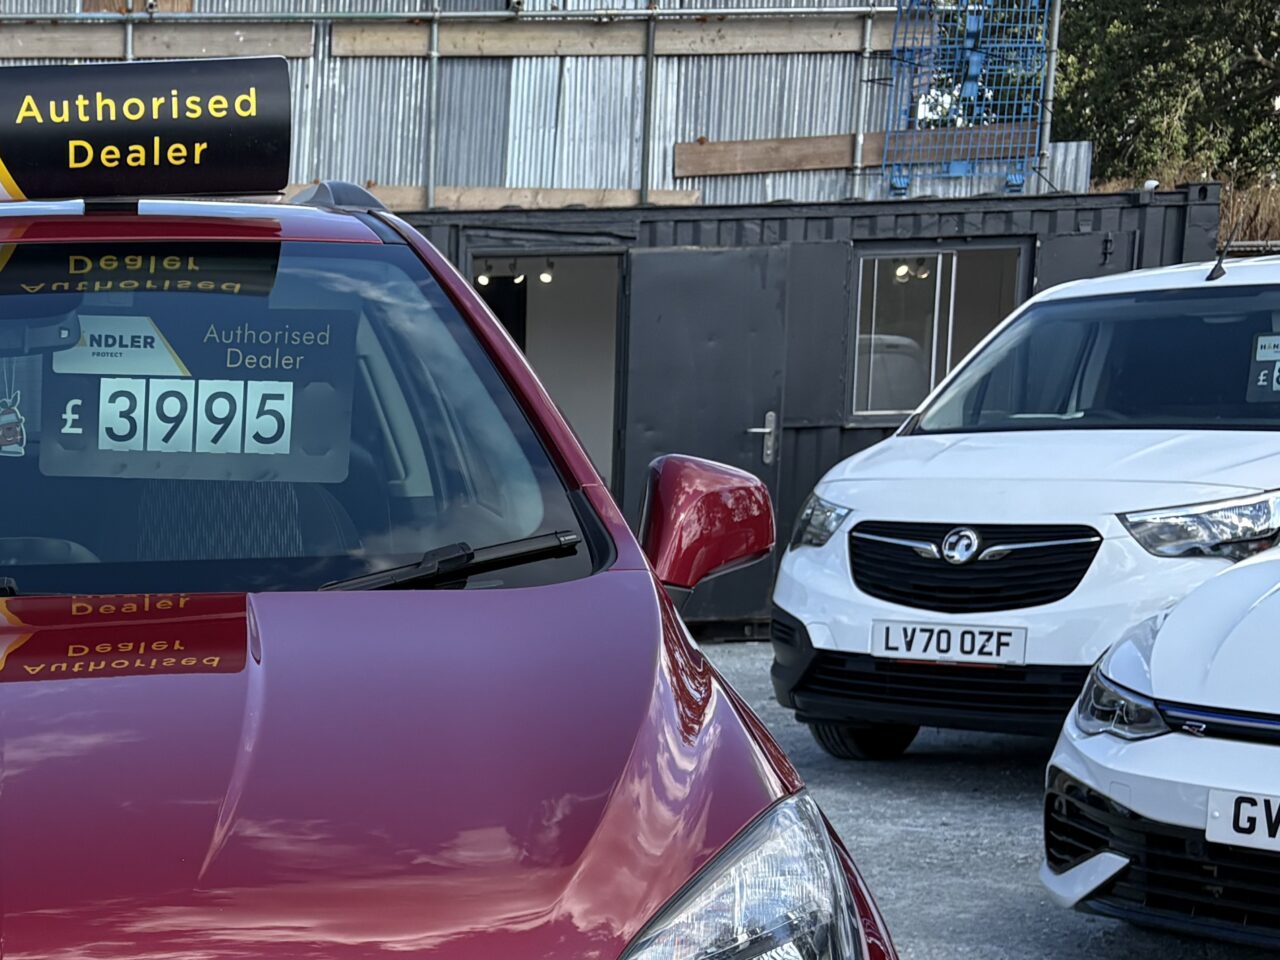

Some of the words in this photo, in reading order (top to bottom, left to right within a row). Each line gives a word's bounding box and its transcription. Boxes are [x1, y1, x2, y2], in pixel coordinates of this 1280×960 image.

[16, 87, 257, 124] Authorised
[68, 136, 208, 169] Dealer
[203, 323, 331, 345] Authorised
[91, 351, 124, 359] PROTECT
[225, 348, 305, 369] Dealer
[884, 626, 952, 654] LV70
[959, 629, 1013, 657] OZF
